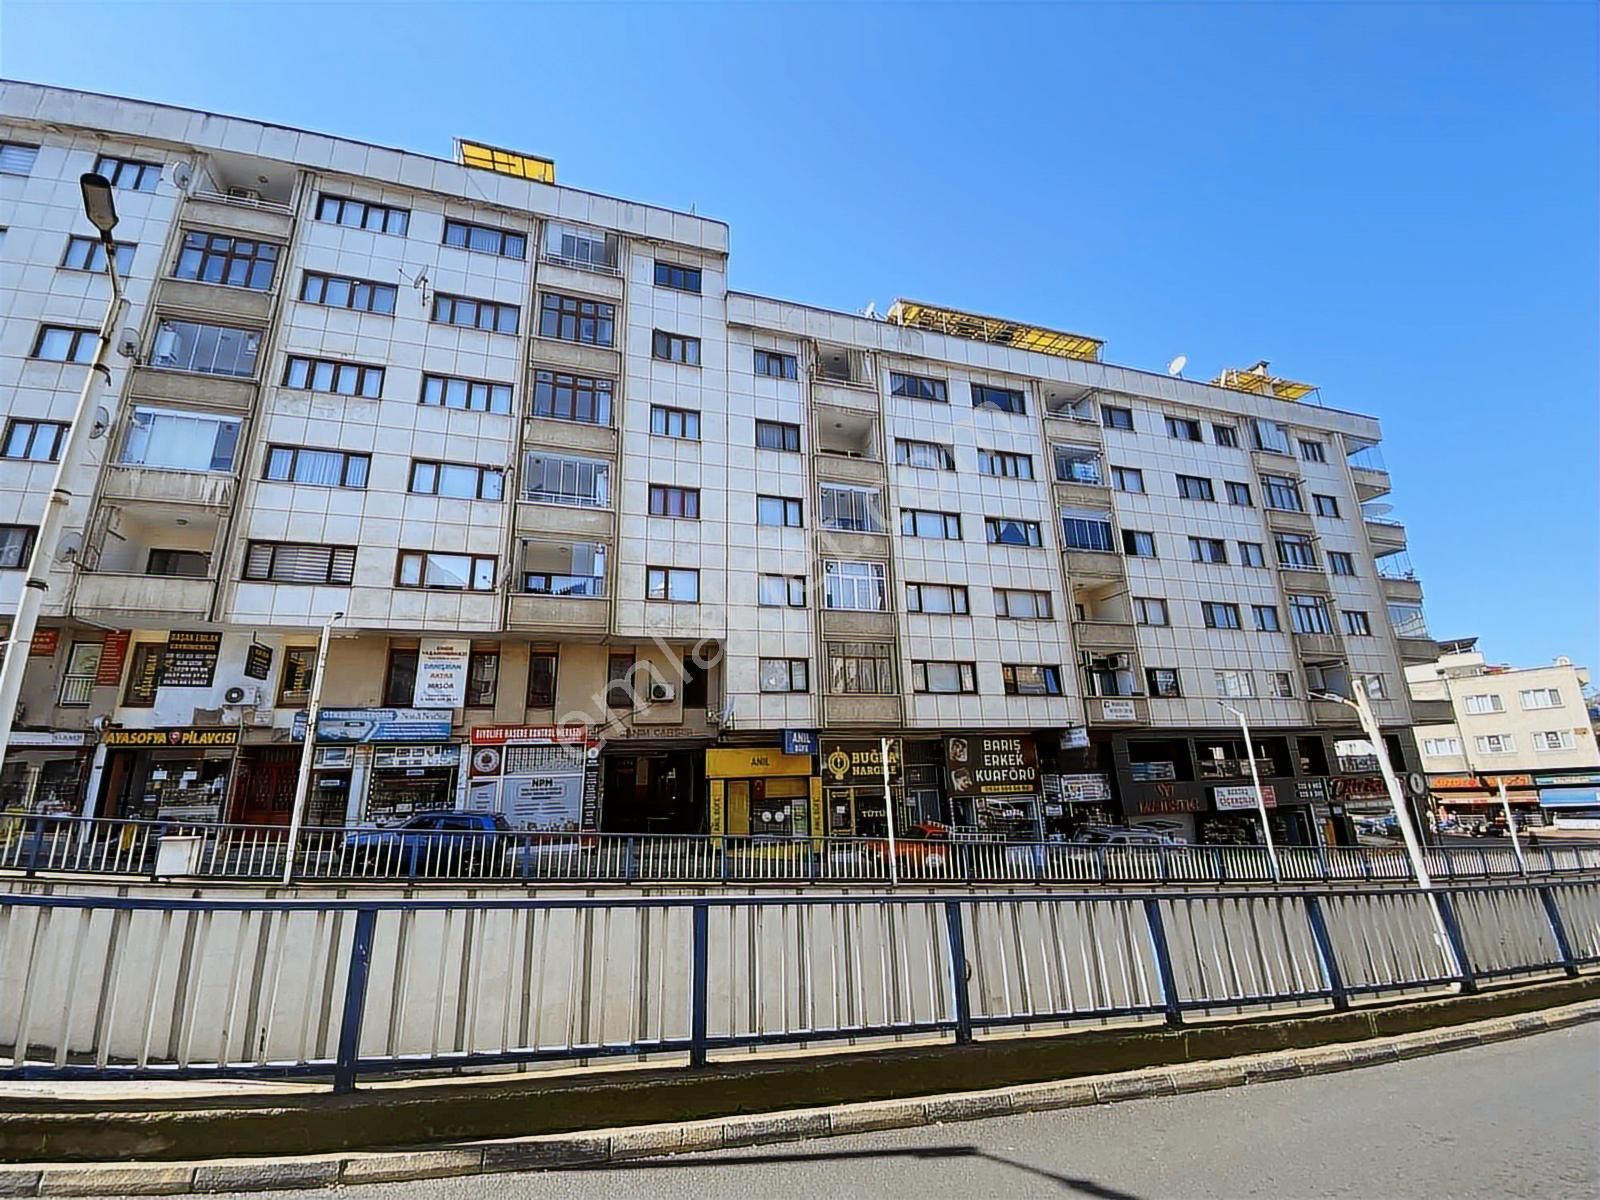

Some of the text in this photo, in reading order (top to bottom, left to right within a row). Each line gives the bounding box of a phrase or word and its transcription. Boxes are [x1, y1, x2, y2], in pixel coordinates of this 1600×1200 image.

[105, 732, 167, 745] AYASOFYA
[983, 739, 1021, 754] BARIŞ
[750, 757, 770, 767] ANIL
[852, 749, 897, 764] BUĞA
[984, 754, 1024, 767] ERKEK
[975, 767, 1036, 782] KUAFÖRÜ
